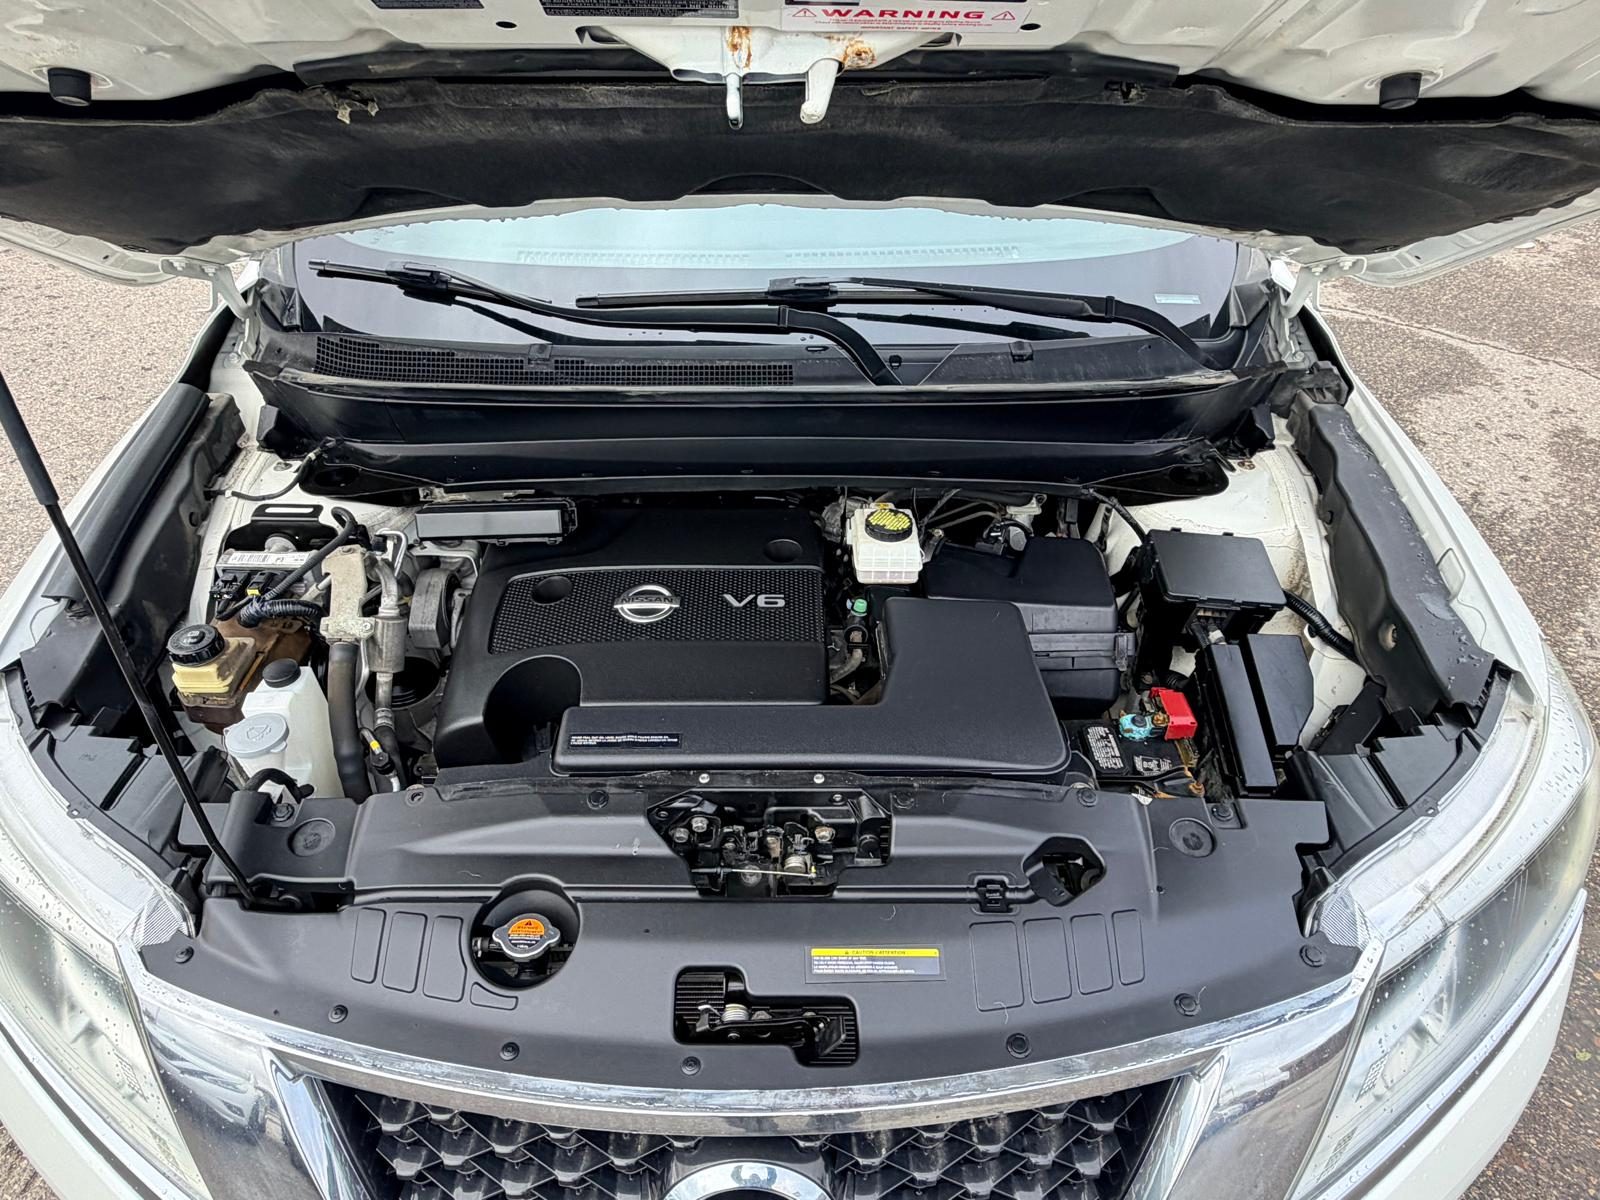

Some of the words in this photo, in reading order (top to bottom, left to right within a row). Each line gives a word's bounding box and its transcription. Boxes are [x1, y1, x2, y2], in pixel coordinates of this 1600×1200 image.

[822, 8, 985, 19] WARNING
[620, 596, 674, 604] NISSAN
[723, 593, 786, 608] V6
